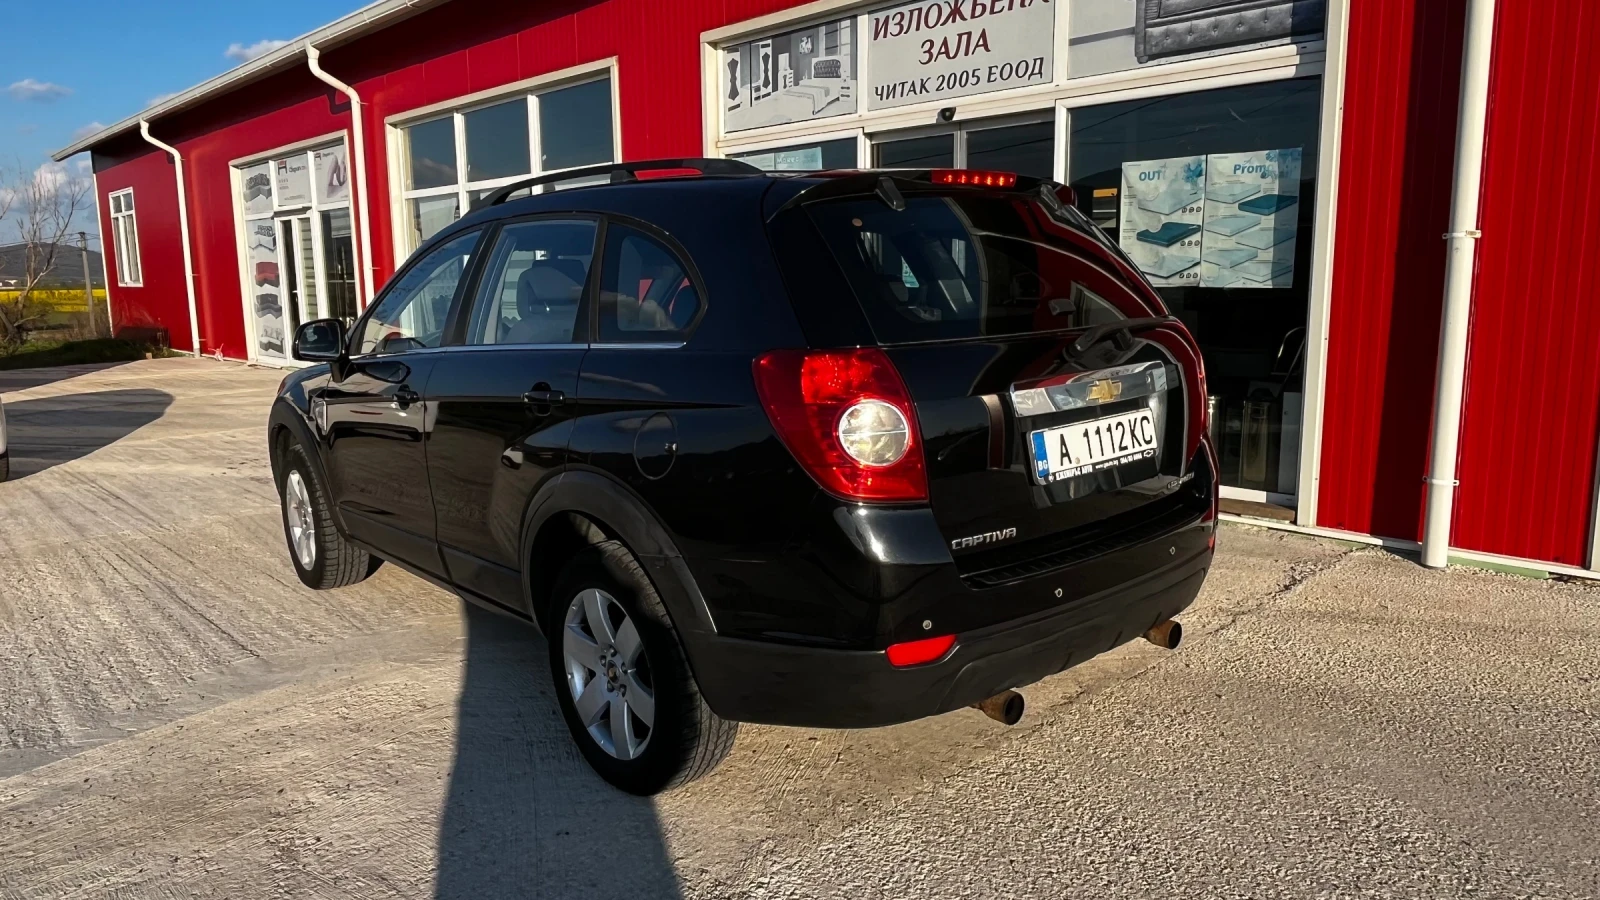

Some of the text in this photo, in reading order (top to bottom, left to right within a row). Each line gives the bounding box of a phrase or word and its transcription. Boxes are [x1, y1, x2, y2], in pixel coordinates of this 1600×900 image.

[873, 0, 1050, 40] ИЗЛОЖБЕ
[918, 28, 991, 65] ЗАЛА
[874, 57, 1044, 101] ЧИТАК 2005 ЕООД
[1037, 459, 1048, 471] BG
[951, 527, 1017, 550] CAPTIVA
